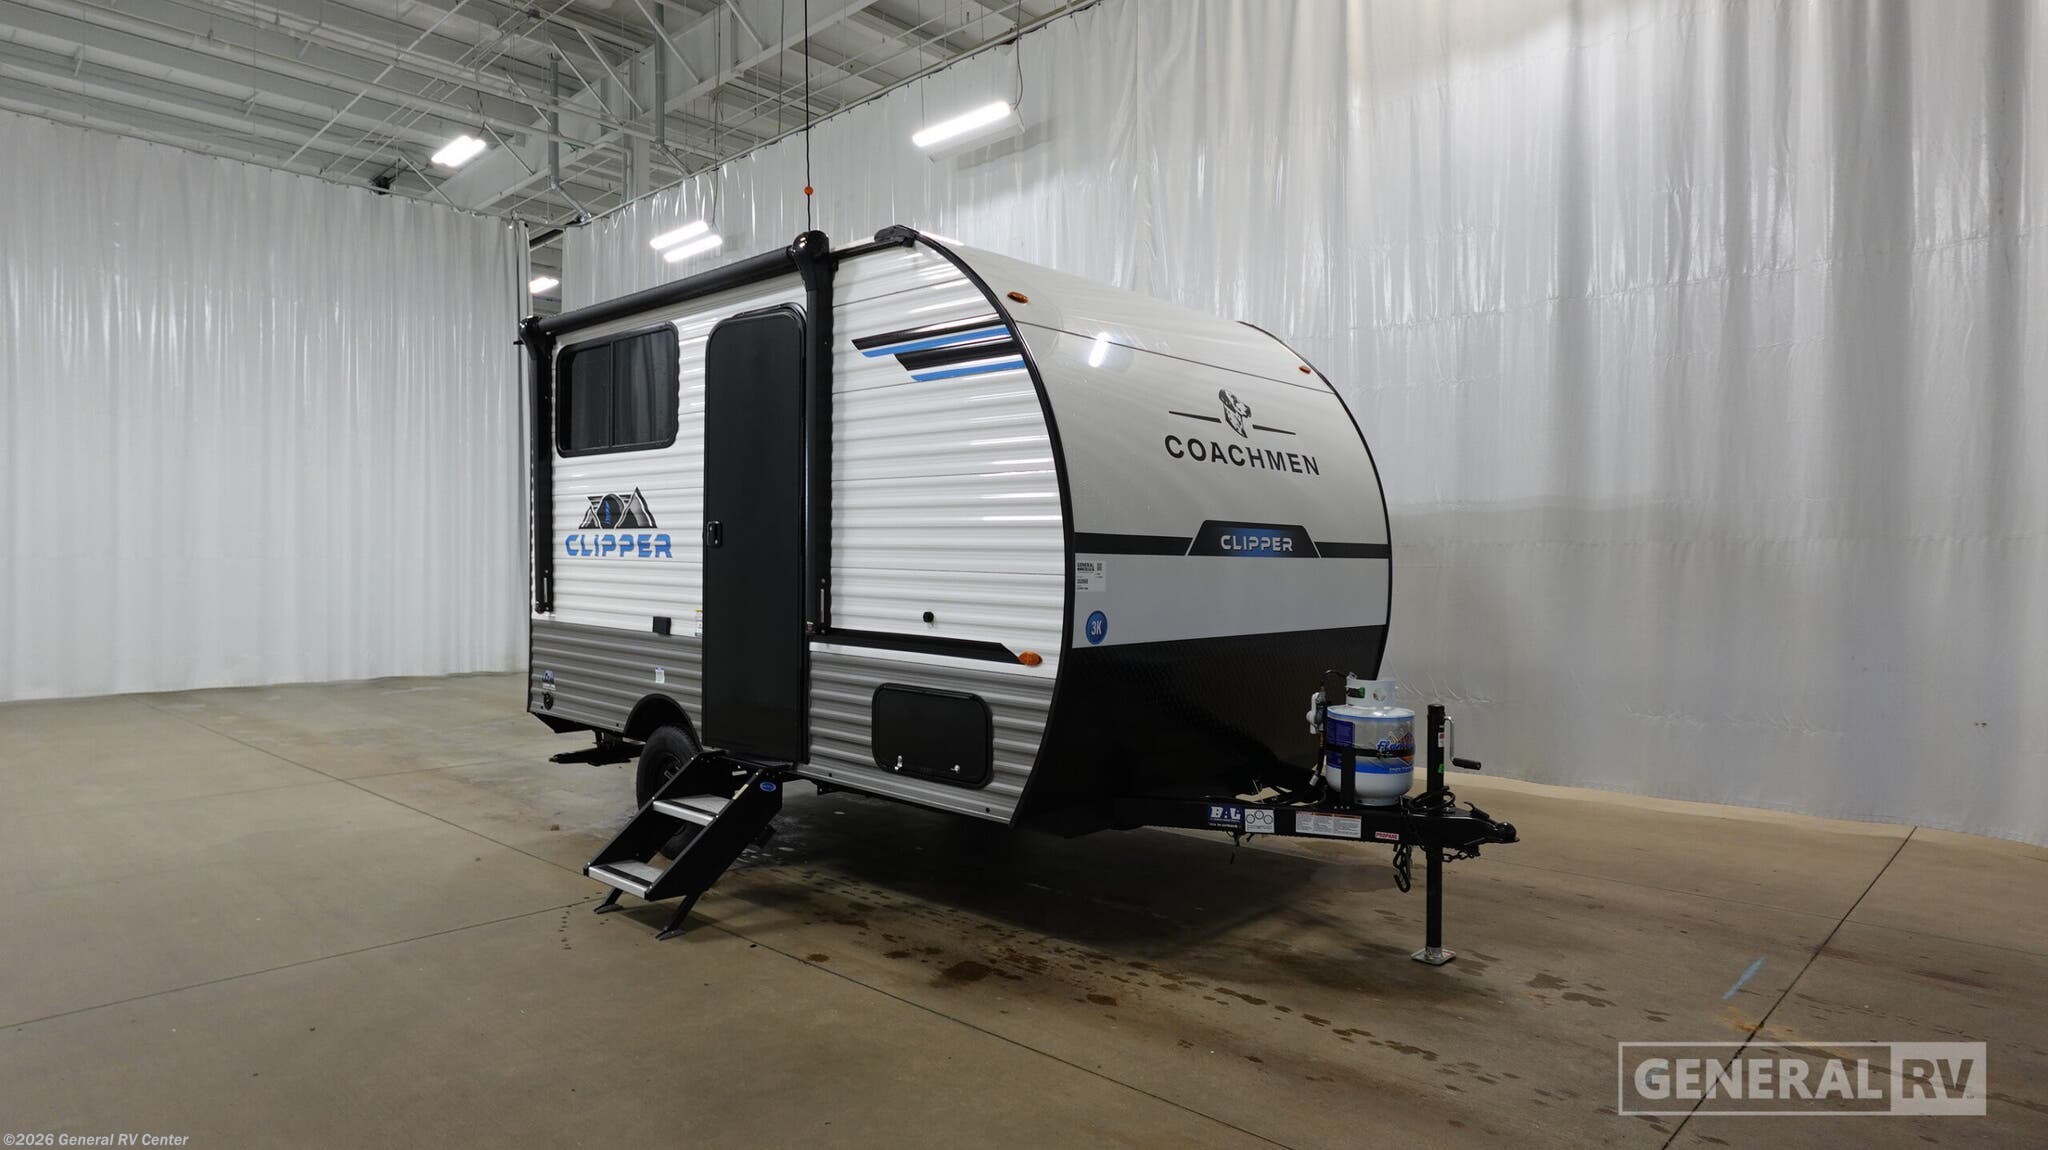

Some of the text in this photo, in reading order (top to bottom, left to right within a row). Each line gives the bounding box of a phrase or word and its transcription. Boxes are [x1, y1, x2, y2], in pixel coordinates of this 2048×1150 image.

[1164, 434, 1320, 476] COACHMEN
[565, 533, 673, 559] CLIPPER
[1220, 535, 1294, 552] CLIPPER
[1091, 620, 1102, 635] 3K
